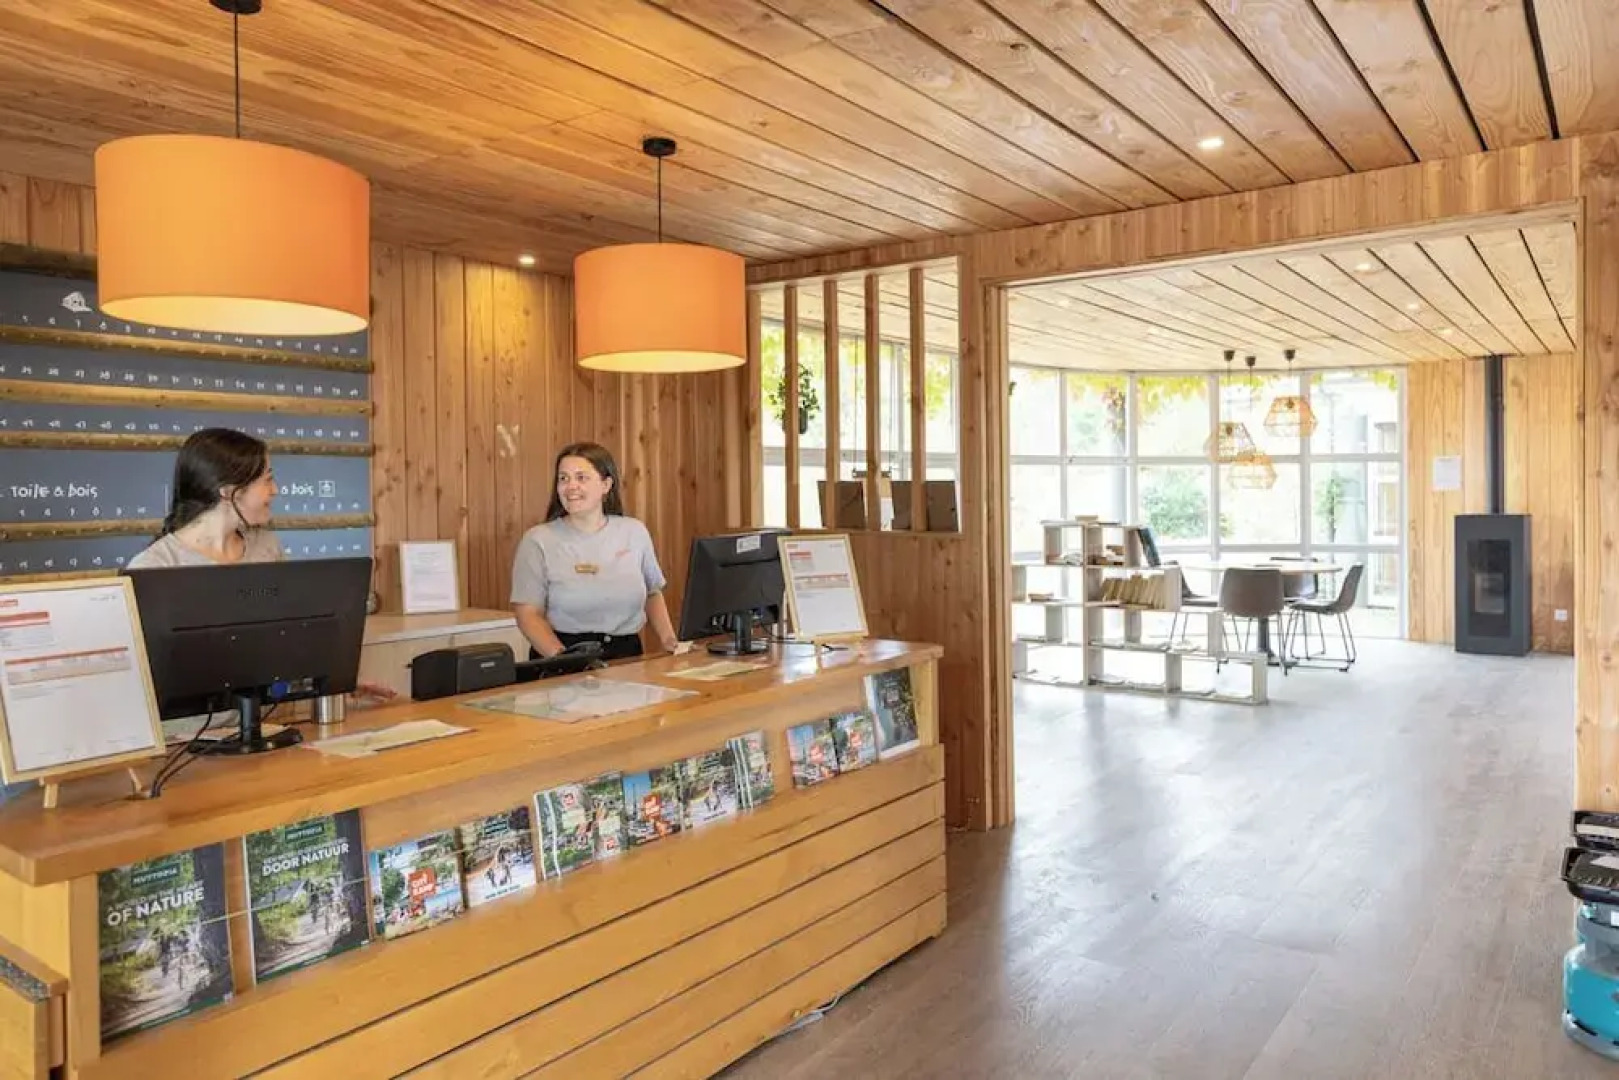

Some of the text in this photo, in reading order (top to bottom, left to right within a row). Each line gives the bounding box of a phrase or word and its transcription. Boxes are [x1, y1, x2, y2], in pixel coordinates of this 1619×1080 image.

[262, 857, 299, 877] DOOR
[302, 842, 349, 867] NATUUR
[107, 907, 132, 926] OF
[136, 886, 204, 919] NATURE
